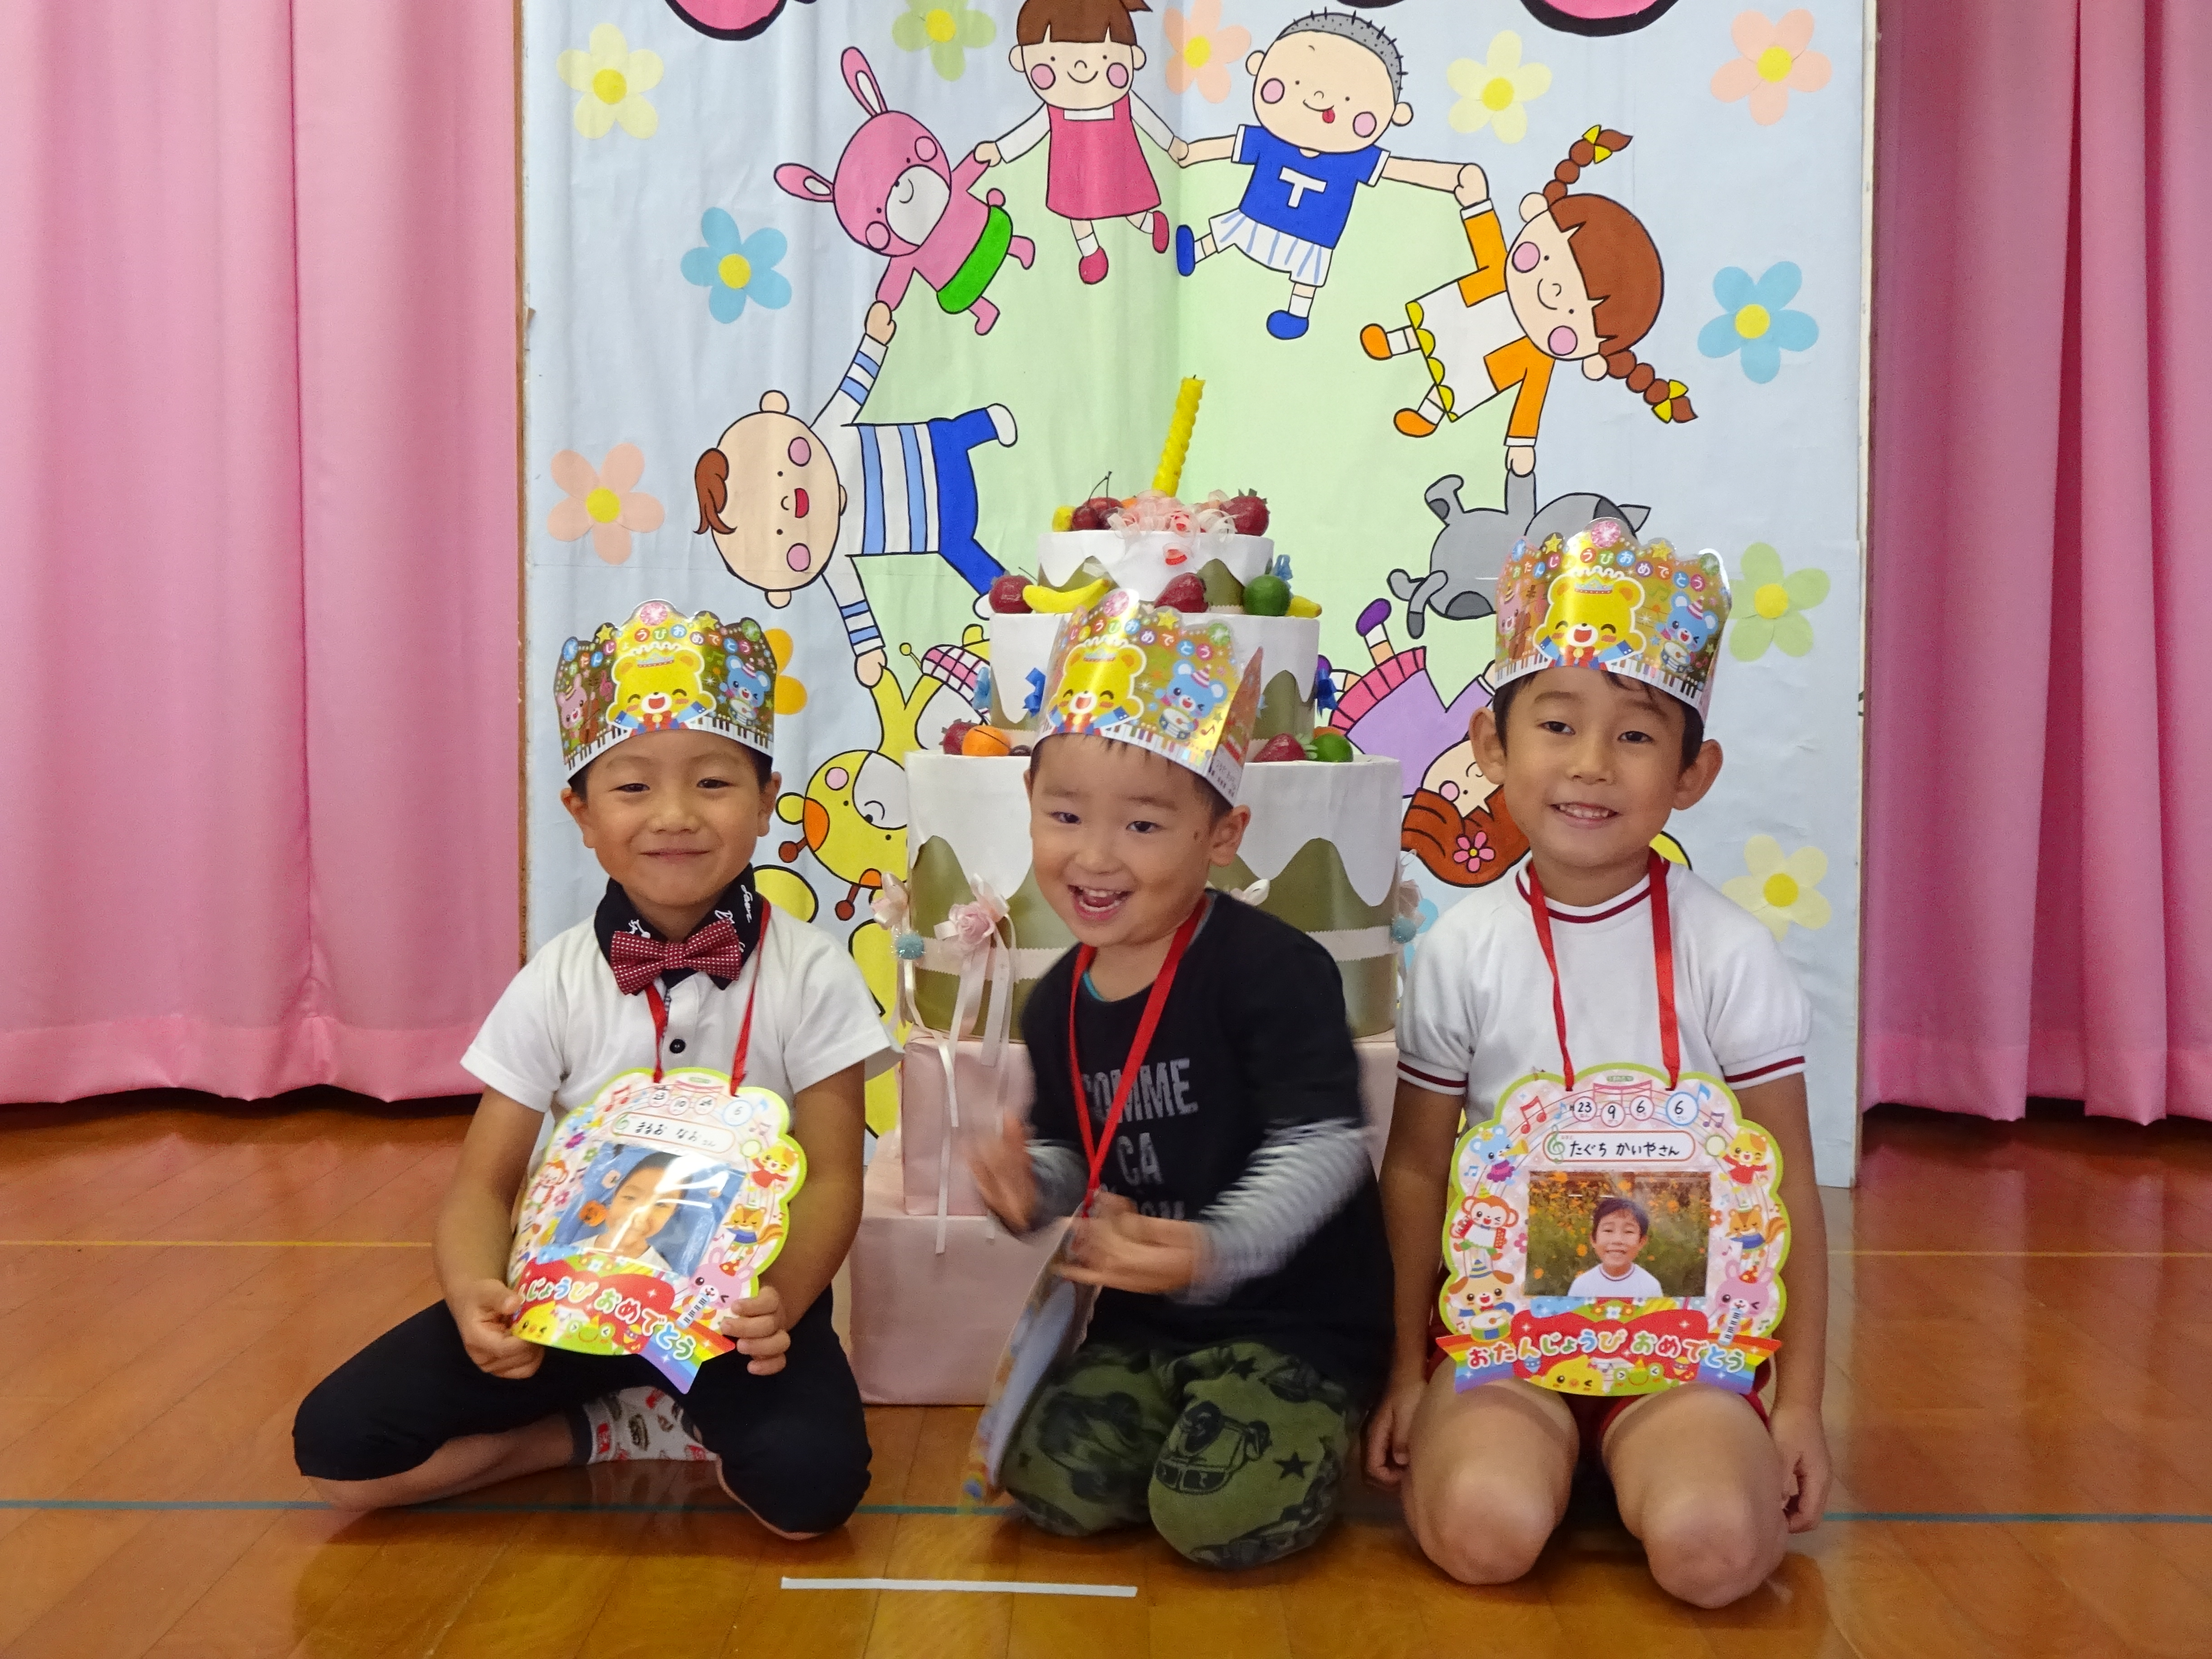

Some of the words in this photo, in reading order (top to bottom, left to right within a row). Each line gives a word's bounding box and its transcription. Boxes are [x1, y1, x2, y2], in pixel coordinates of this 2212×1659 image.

[1278, 166, 1327, 208] T
[1607, 1105, 1616, 1119] 9
[1636, 1100, 1645, 1113] 6
[1675, 1101, 1683, 1115] 6
[1117, 1132, 1164, 1186] CA
[1570, 1140, 1607, 1157] たぐち
[518, 1276, 600, 1303] じょうび
[593, 1288, 697, 1361] おめでとう
[1466, 1328, 1626, 1369] おたんじょうび
[1631, 1331, 1748, 1373] おめでとう
